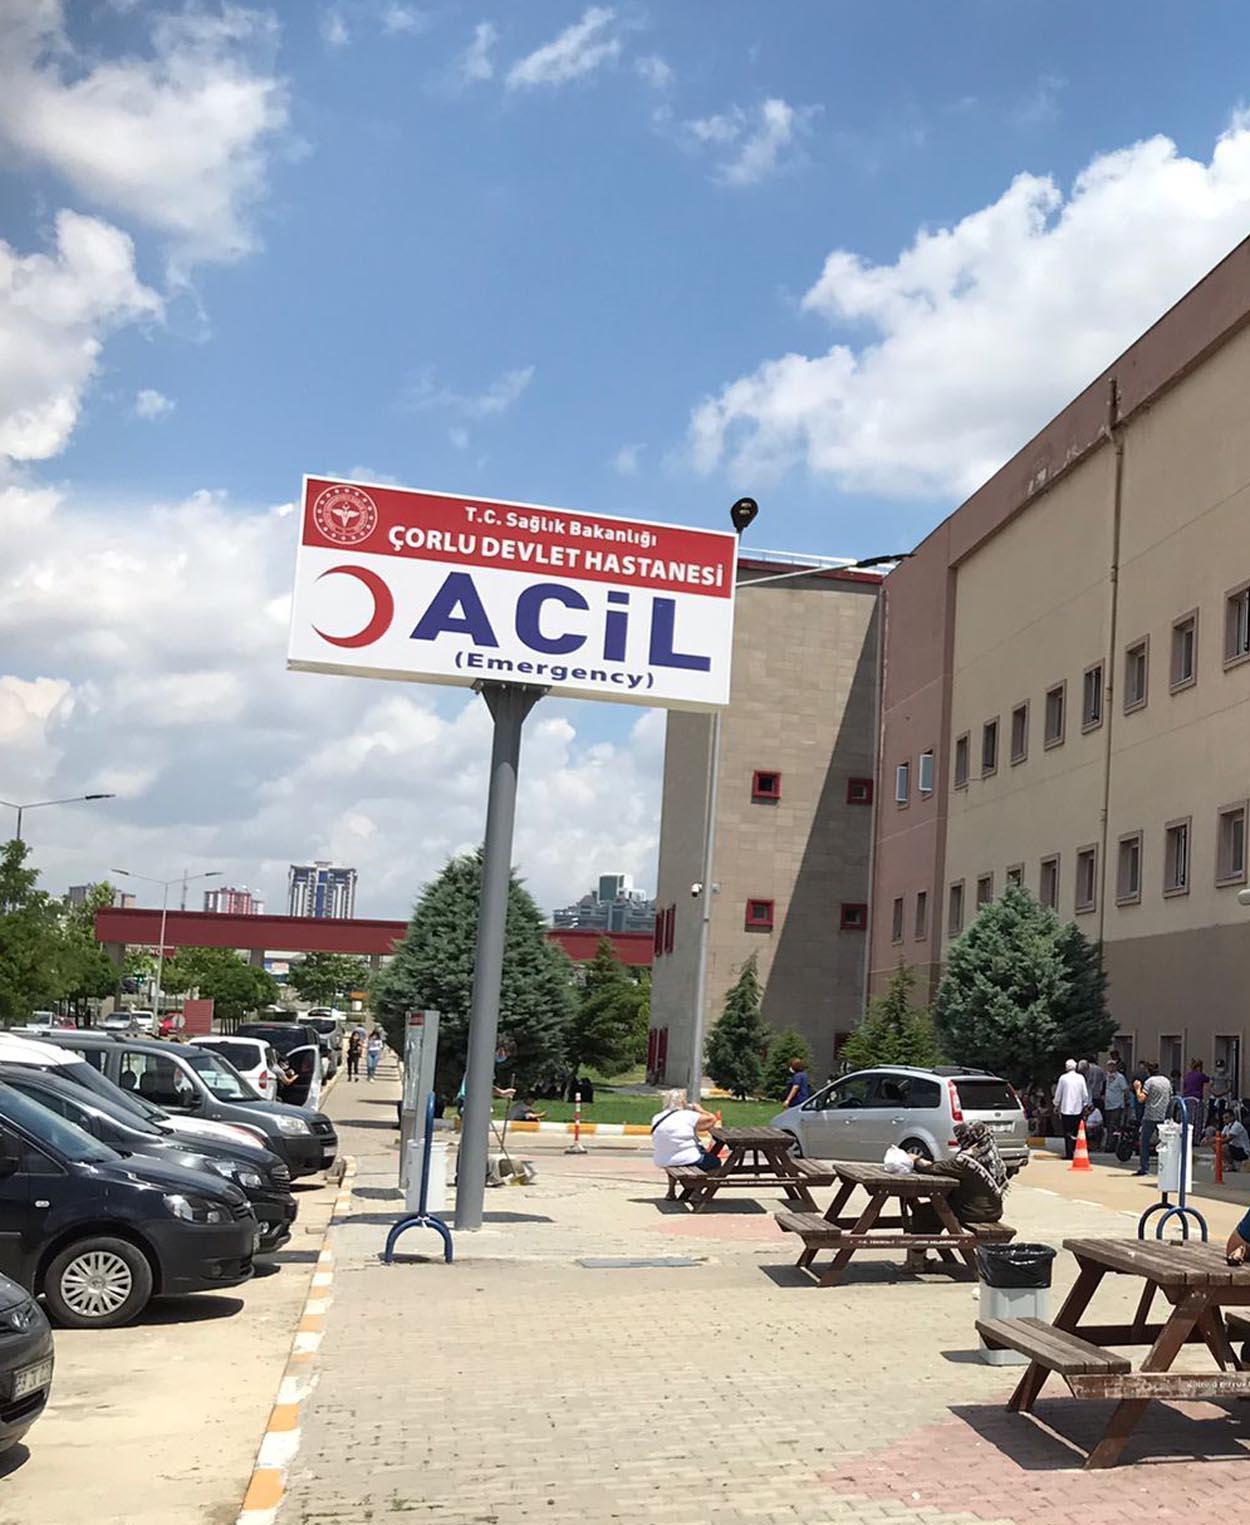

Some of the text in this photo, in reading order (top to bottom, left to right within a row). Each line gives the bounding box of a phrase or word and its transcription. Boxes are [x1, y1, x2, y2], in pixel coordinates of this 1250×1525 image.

[465, 506, 657, 548] T.C. Sağlık Bakanlığı
[388, 525, 725, 588] ÇORLU DEVLET HASTANESİ
[455, 651, 655, 689] (Emergency)
